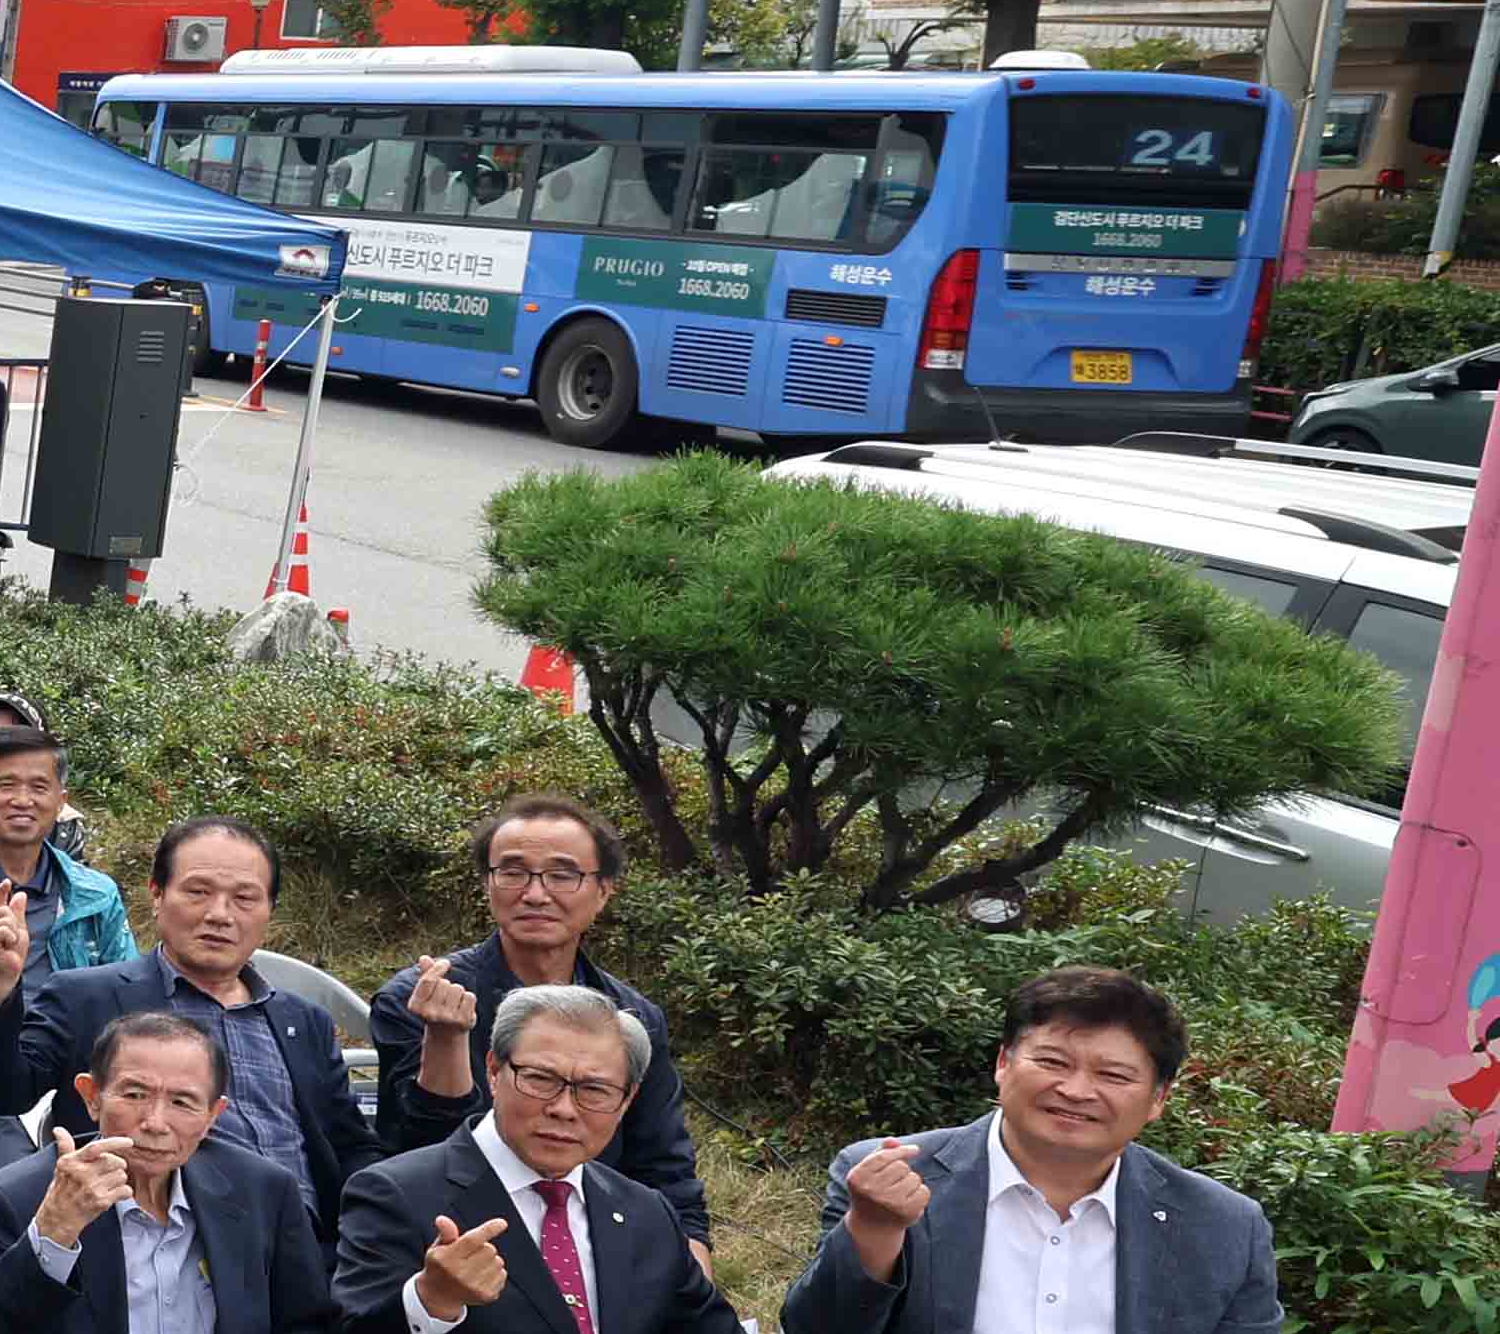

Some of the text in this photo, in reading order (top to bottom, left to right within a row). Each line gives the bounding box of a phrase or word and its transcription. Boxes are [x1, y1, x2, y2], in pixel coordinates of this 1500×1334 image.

[1132, 129, 1214, 166] 24
[348, 243, 493, 279] 신도시 푸르지오 더 파크
[594, 256, 665, 277] PRUGIO
[829, 264, 893, 286] 해성운수
[1085, 276, 1156, 297] 해성운수
[677, 277, 749, 300] 1668.2060
[415, 290, 490, 316] 1668.2060
